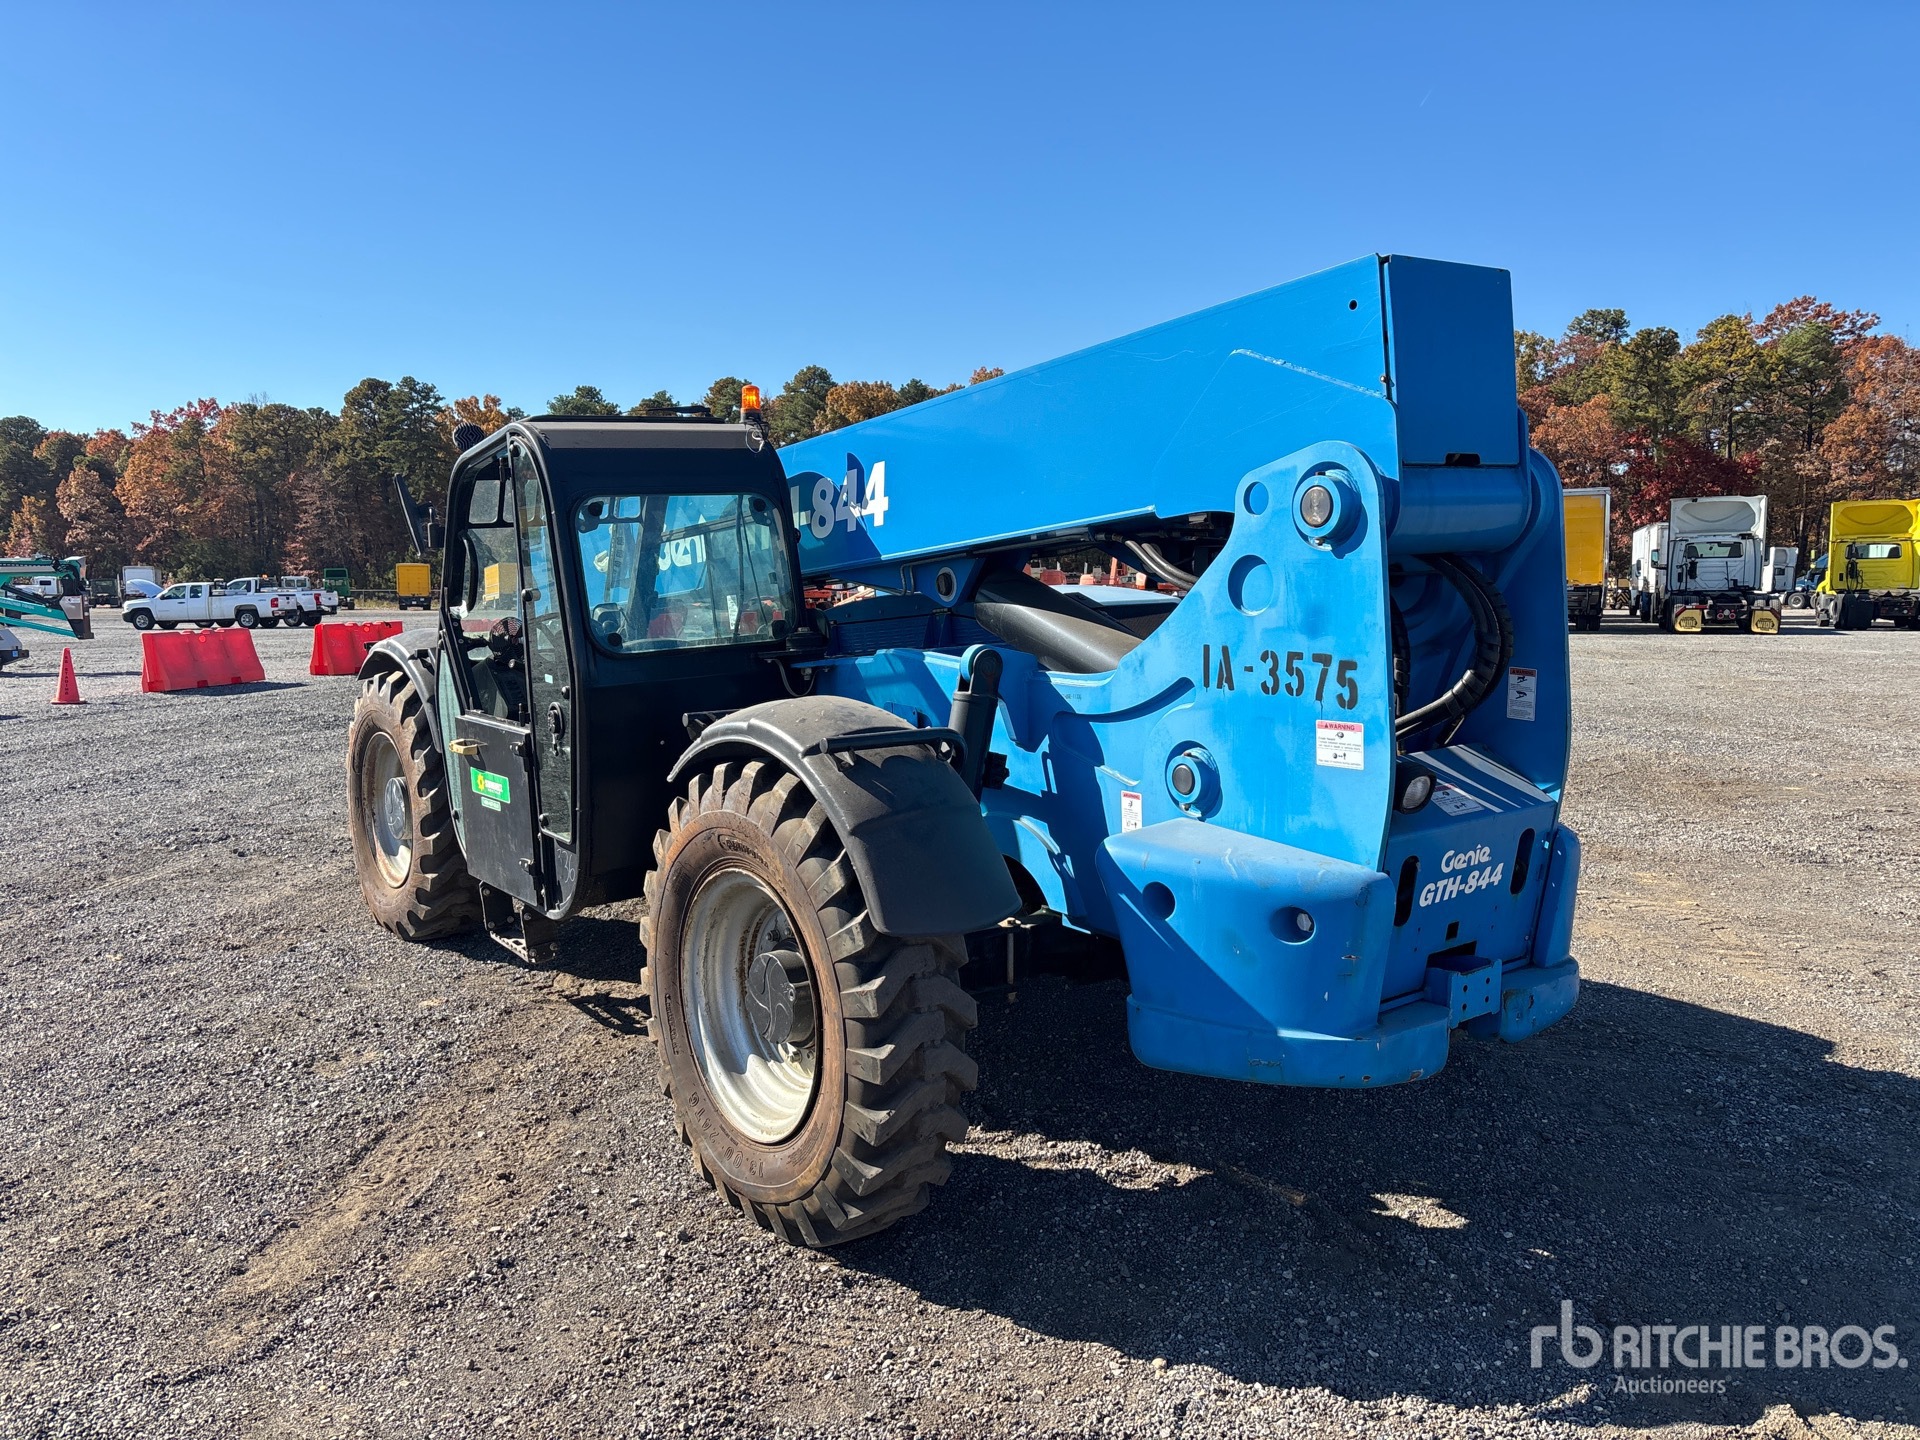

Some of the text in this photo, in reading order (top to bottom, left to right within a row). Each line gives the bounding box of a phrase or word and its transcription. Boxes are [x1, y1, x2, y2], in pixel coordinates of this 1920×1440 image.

[1329, 723, 1355, 731] WARNING
[1441, 843, 1491, 874] Genie
[1419, 862, 1504, 907] GTH-844
